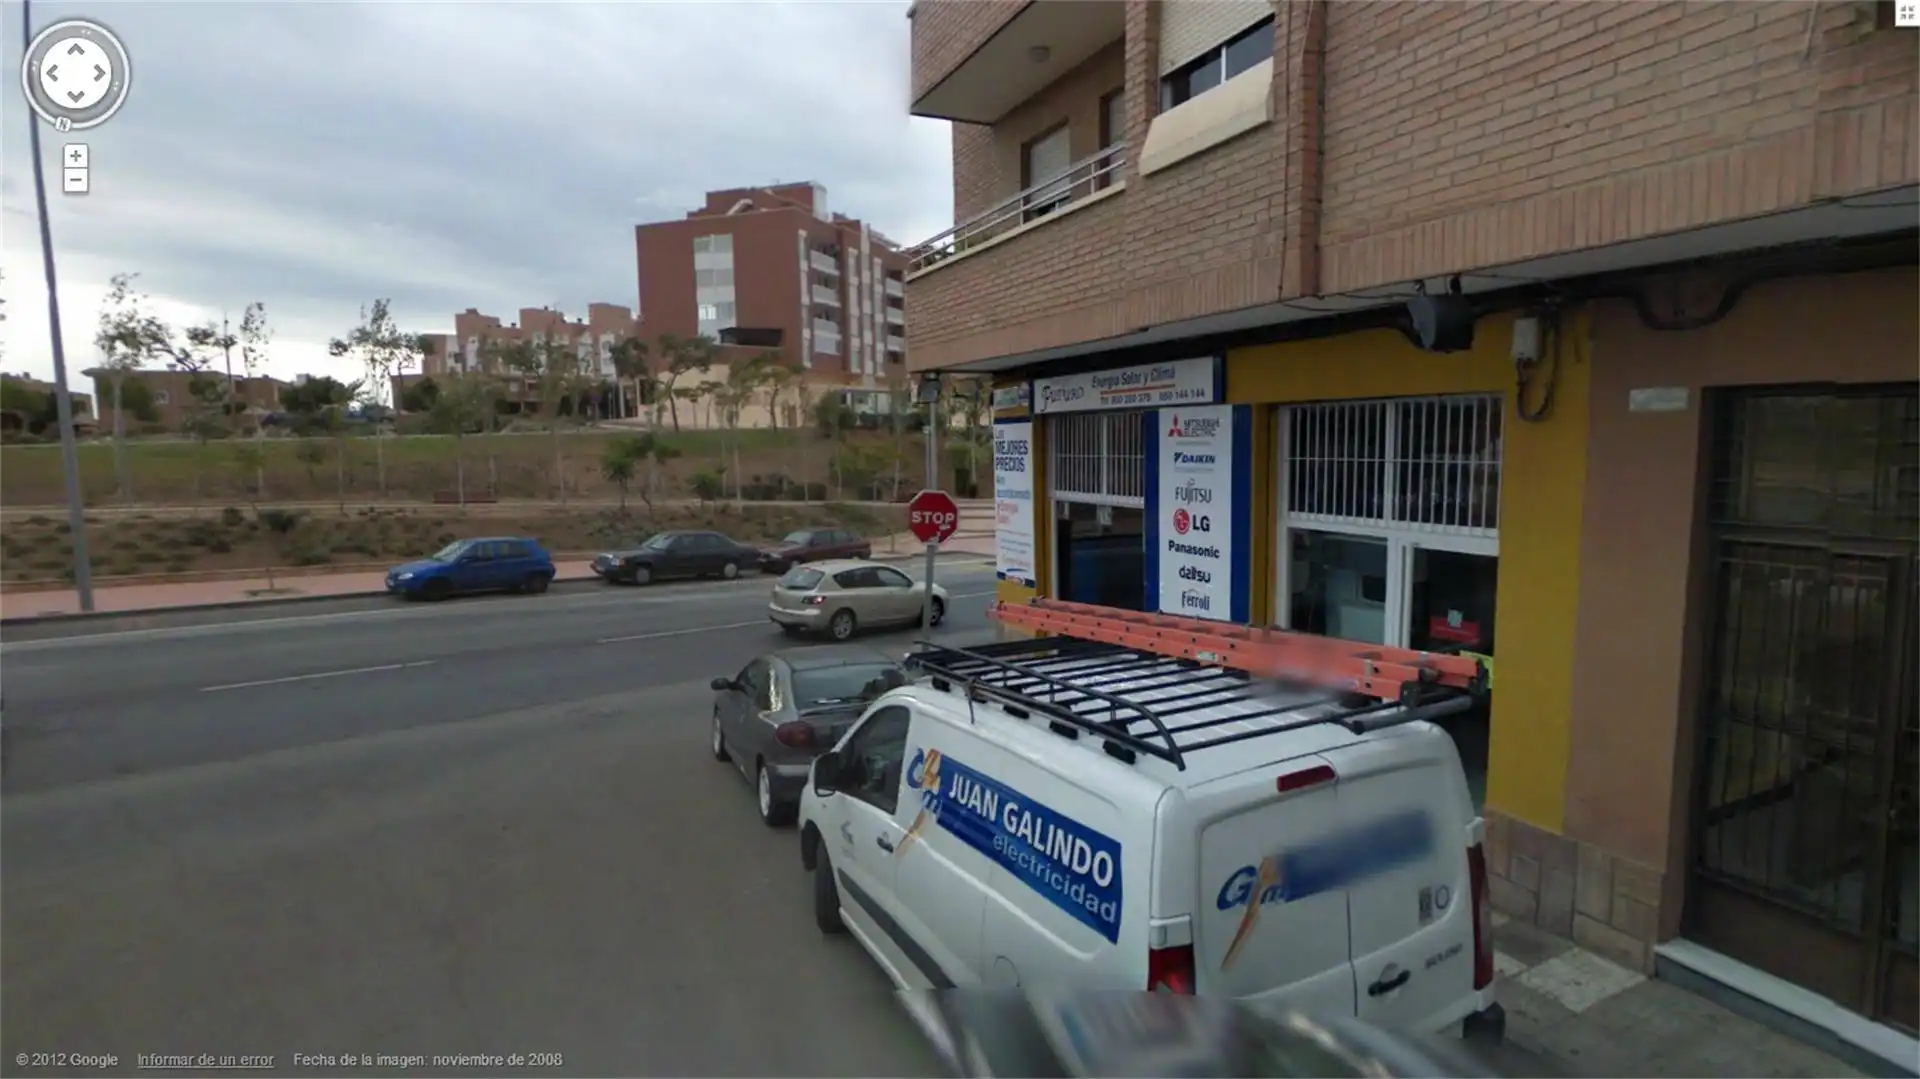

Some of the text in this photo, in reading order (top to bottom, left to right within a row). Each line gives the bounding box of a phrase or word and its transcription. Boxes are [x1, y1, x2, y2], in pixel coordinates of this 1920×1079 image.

[1181, 454, 1216, 464] DAIKIN
[1175, 486, 1212, 505] FUJITSU
[911, 511, 955, 525] STOP
[1192, 514, 1210, 532] LG
[1168, 540, 1220, 558] Panasonic
[948, 772, 1114, 888] JUAN GALINDO
[992, 834, 1117, 924] electricidad
